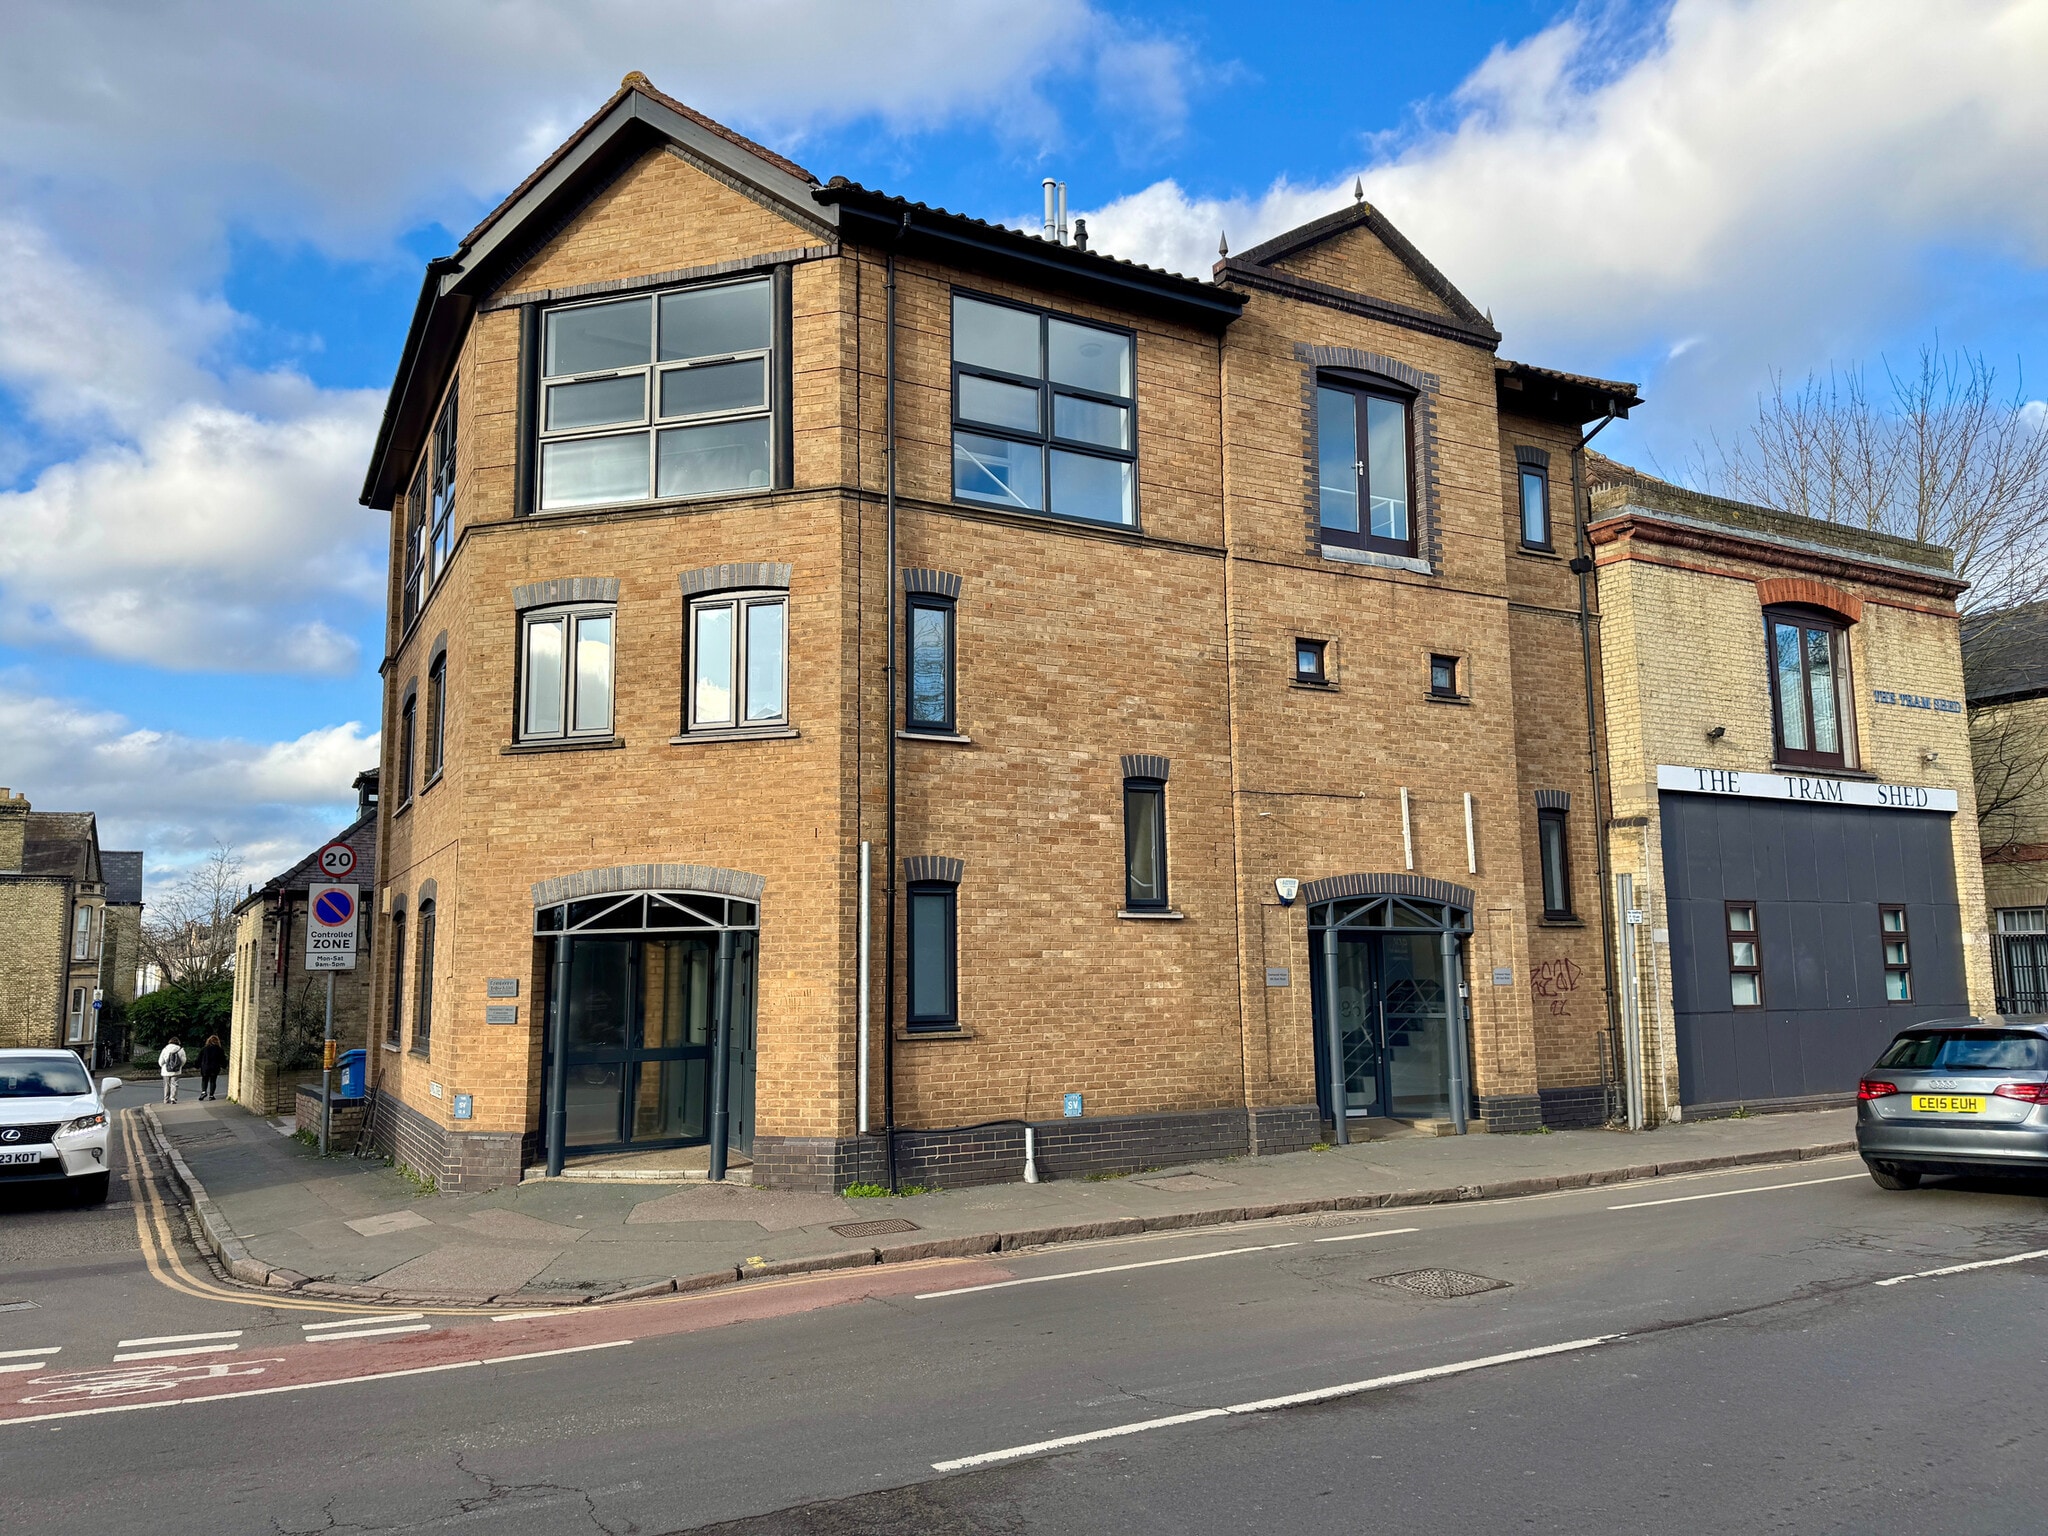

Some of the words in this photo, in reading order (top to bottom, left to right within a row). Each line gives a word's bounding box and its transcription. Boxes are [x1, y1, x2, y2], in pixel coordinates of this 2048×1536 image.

[1874, 690, 1895, 704] THE
[1899, 694, 1931, 709] TRAM
[1934, 699, 1961, 713] SHED
[1694, 768, 1740, 793] THE
[1784, 776, 1844, 802] TRAM
[1877, 784, 1928, 808] SHED
[325, 853, 351, 867] 20
[313, 940, 350, 949] ZONE
[1068, 1101, 1078, 1109] SV
[1919, 1097, 1947, 1109] CE15
[1951, 1098, 1977, 1110] EUH
[14, 1153, 36, 1163] KOT
